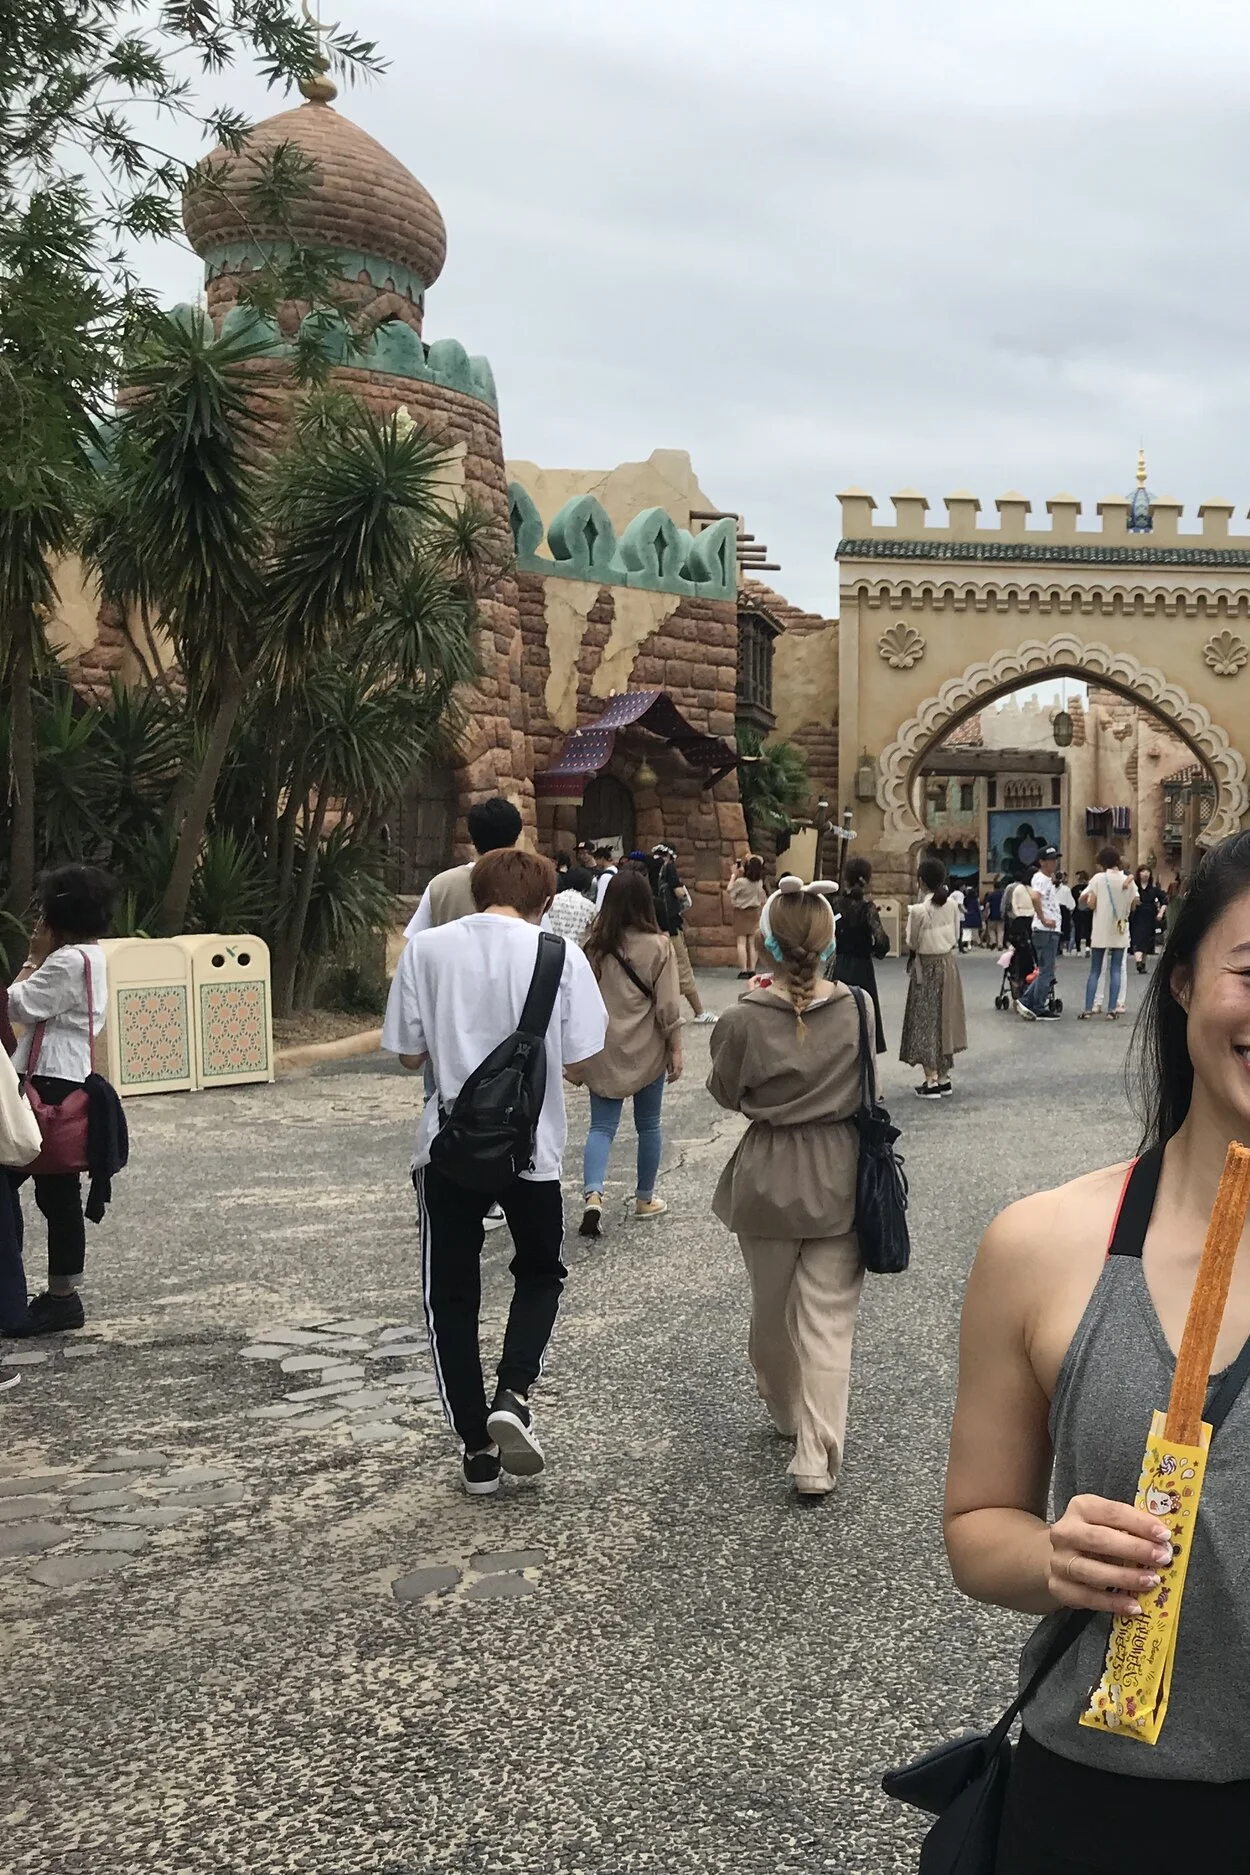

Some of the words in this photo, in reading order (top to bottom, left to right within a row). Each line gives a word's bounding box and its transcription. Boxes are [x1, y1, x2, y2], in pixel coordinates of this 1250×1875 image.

[1112, 1616, 1133, 1681] SWEETS
[1123, 1613, 1152, 1687] HALLOWEEN
[1147, 1637, 1163, 1664] Disney
